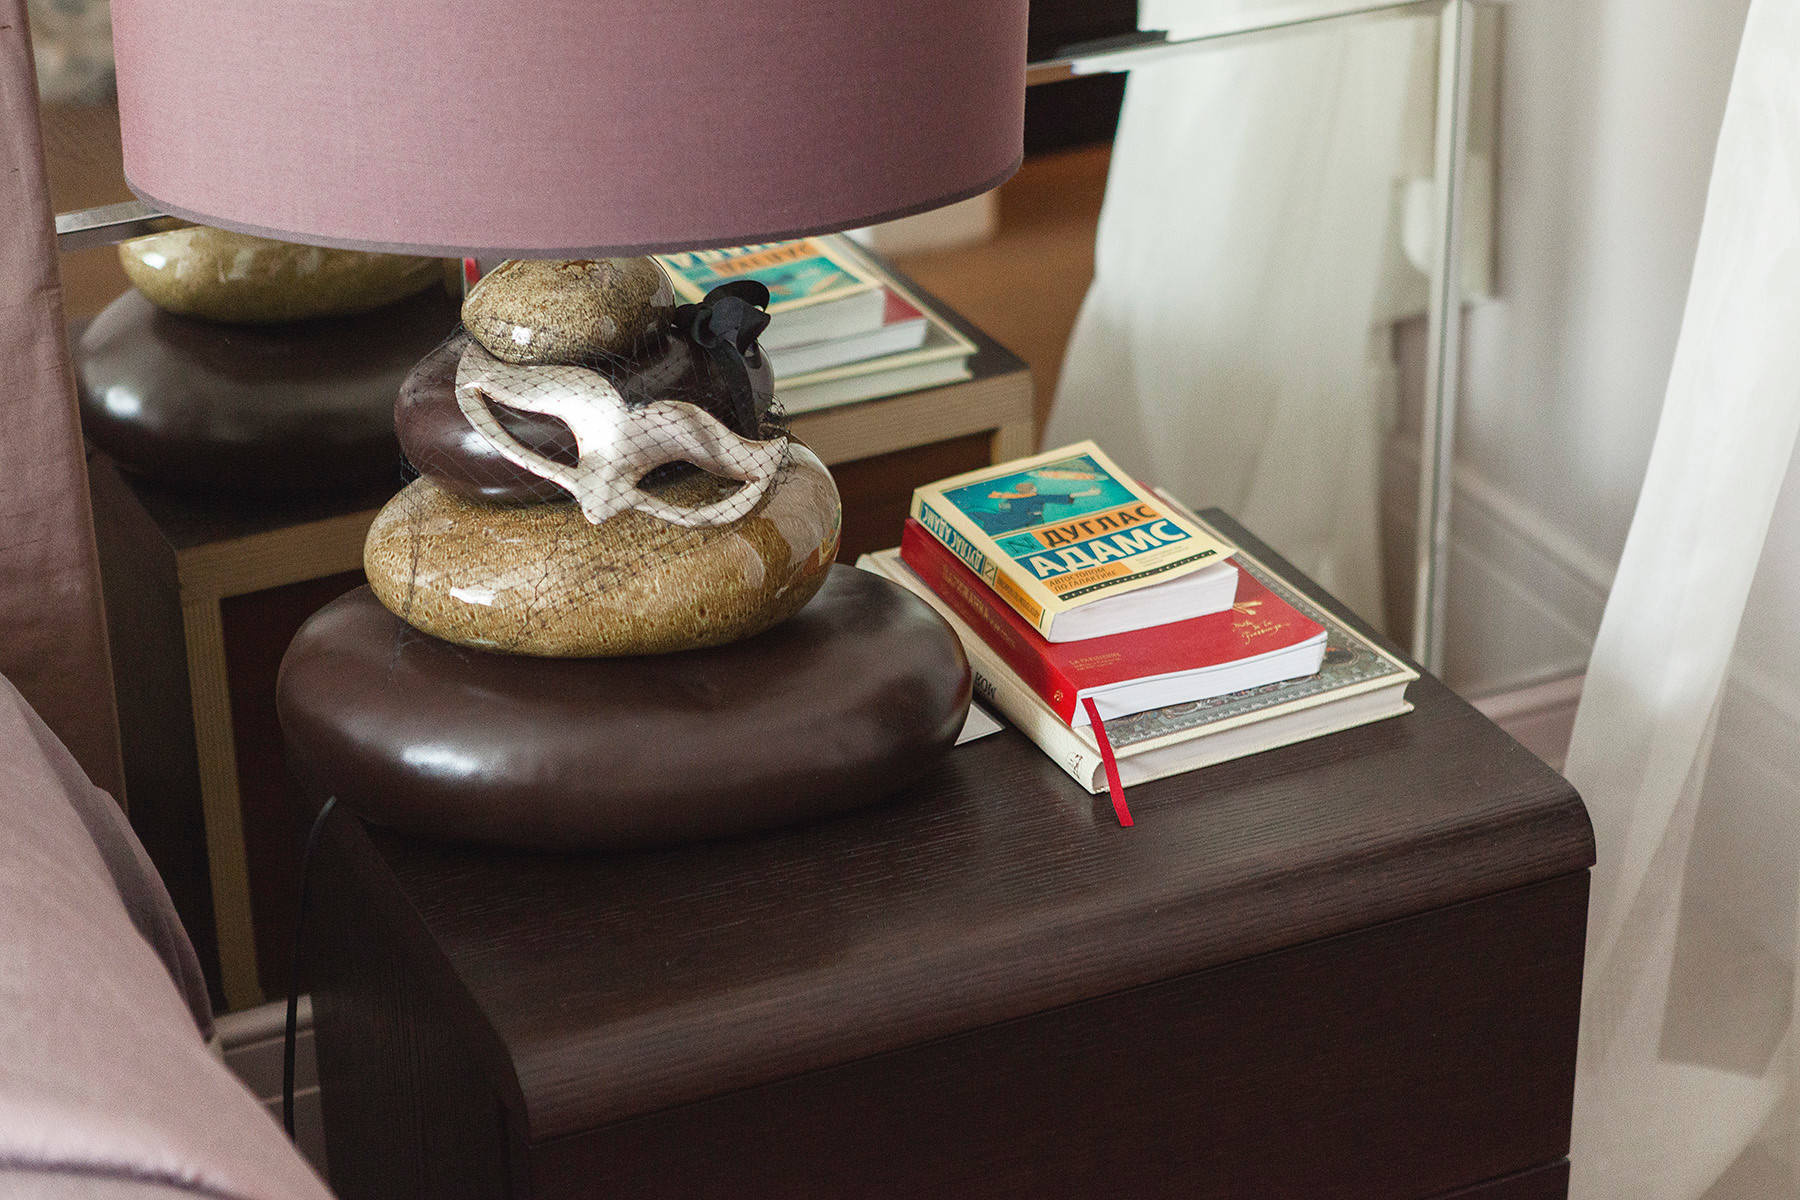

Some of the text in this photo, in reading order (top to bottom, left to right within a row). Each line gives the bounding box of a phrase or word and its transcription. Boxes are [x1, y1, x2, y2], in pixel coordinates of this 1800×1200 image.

[923, 506, 983, 572] ДУГЛАС АДАМС
[1042, 506, 1157, 548] ДУГЛАС
[1029, 521, 1186, 577] АДАМС
[1049, 567, 1106, 588] АВТОСТОПОМ
[1054, 571, 1117, 593] ПО ГАЛАКТИКЕ
